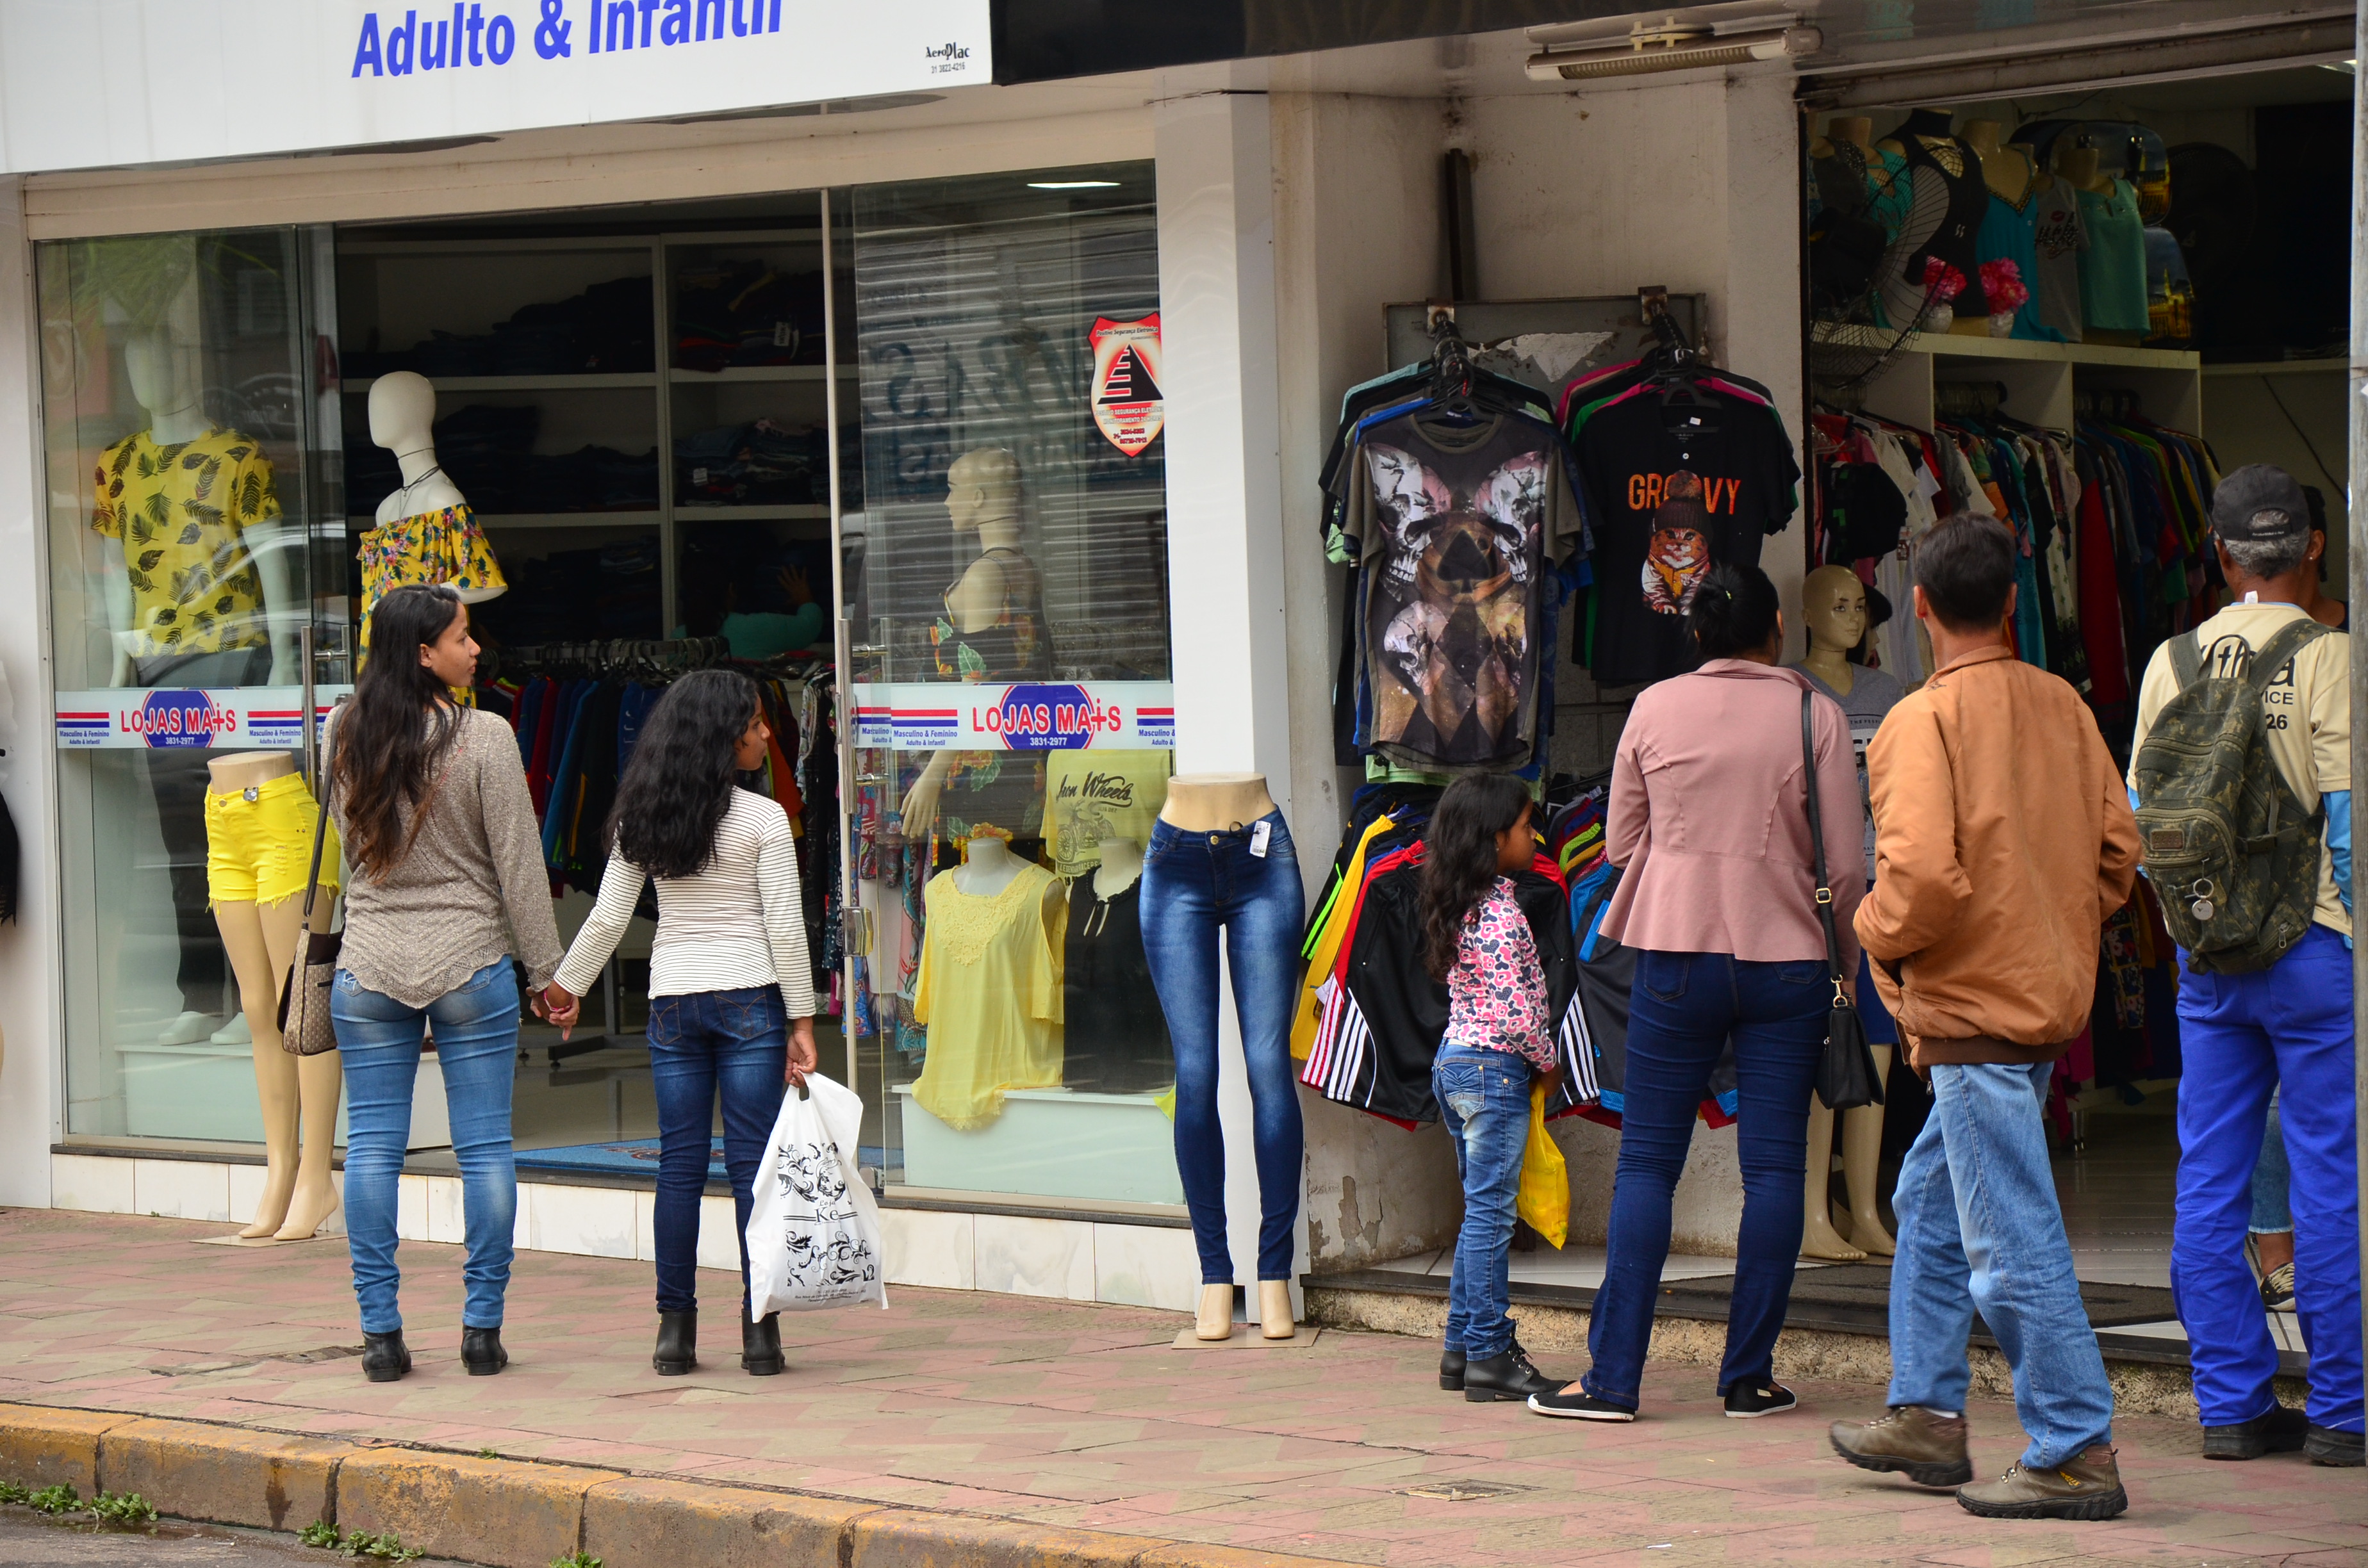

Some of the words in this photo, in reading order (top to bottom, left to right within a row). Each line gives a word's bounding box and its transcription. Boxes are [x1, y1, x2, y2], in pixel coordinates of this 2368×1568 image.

[352, 2, 514, 78] Adulto
[534, 0, 572, 60] &
[1114, 327, 1136, 336] Segurança
[1628, 473, 1741, 515] GRVY
[120, 707, 181, 734] LOJAS
[973, 705, 1049, 733] LOJAS
[165, 737, 195, 746] 3831-2977
[930, 730, 957, 738] Feminino
[1030, 737, 1067, 746] 3831-2977
[1082, 771, 1133, 804] Wheels
